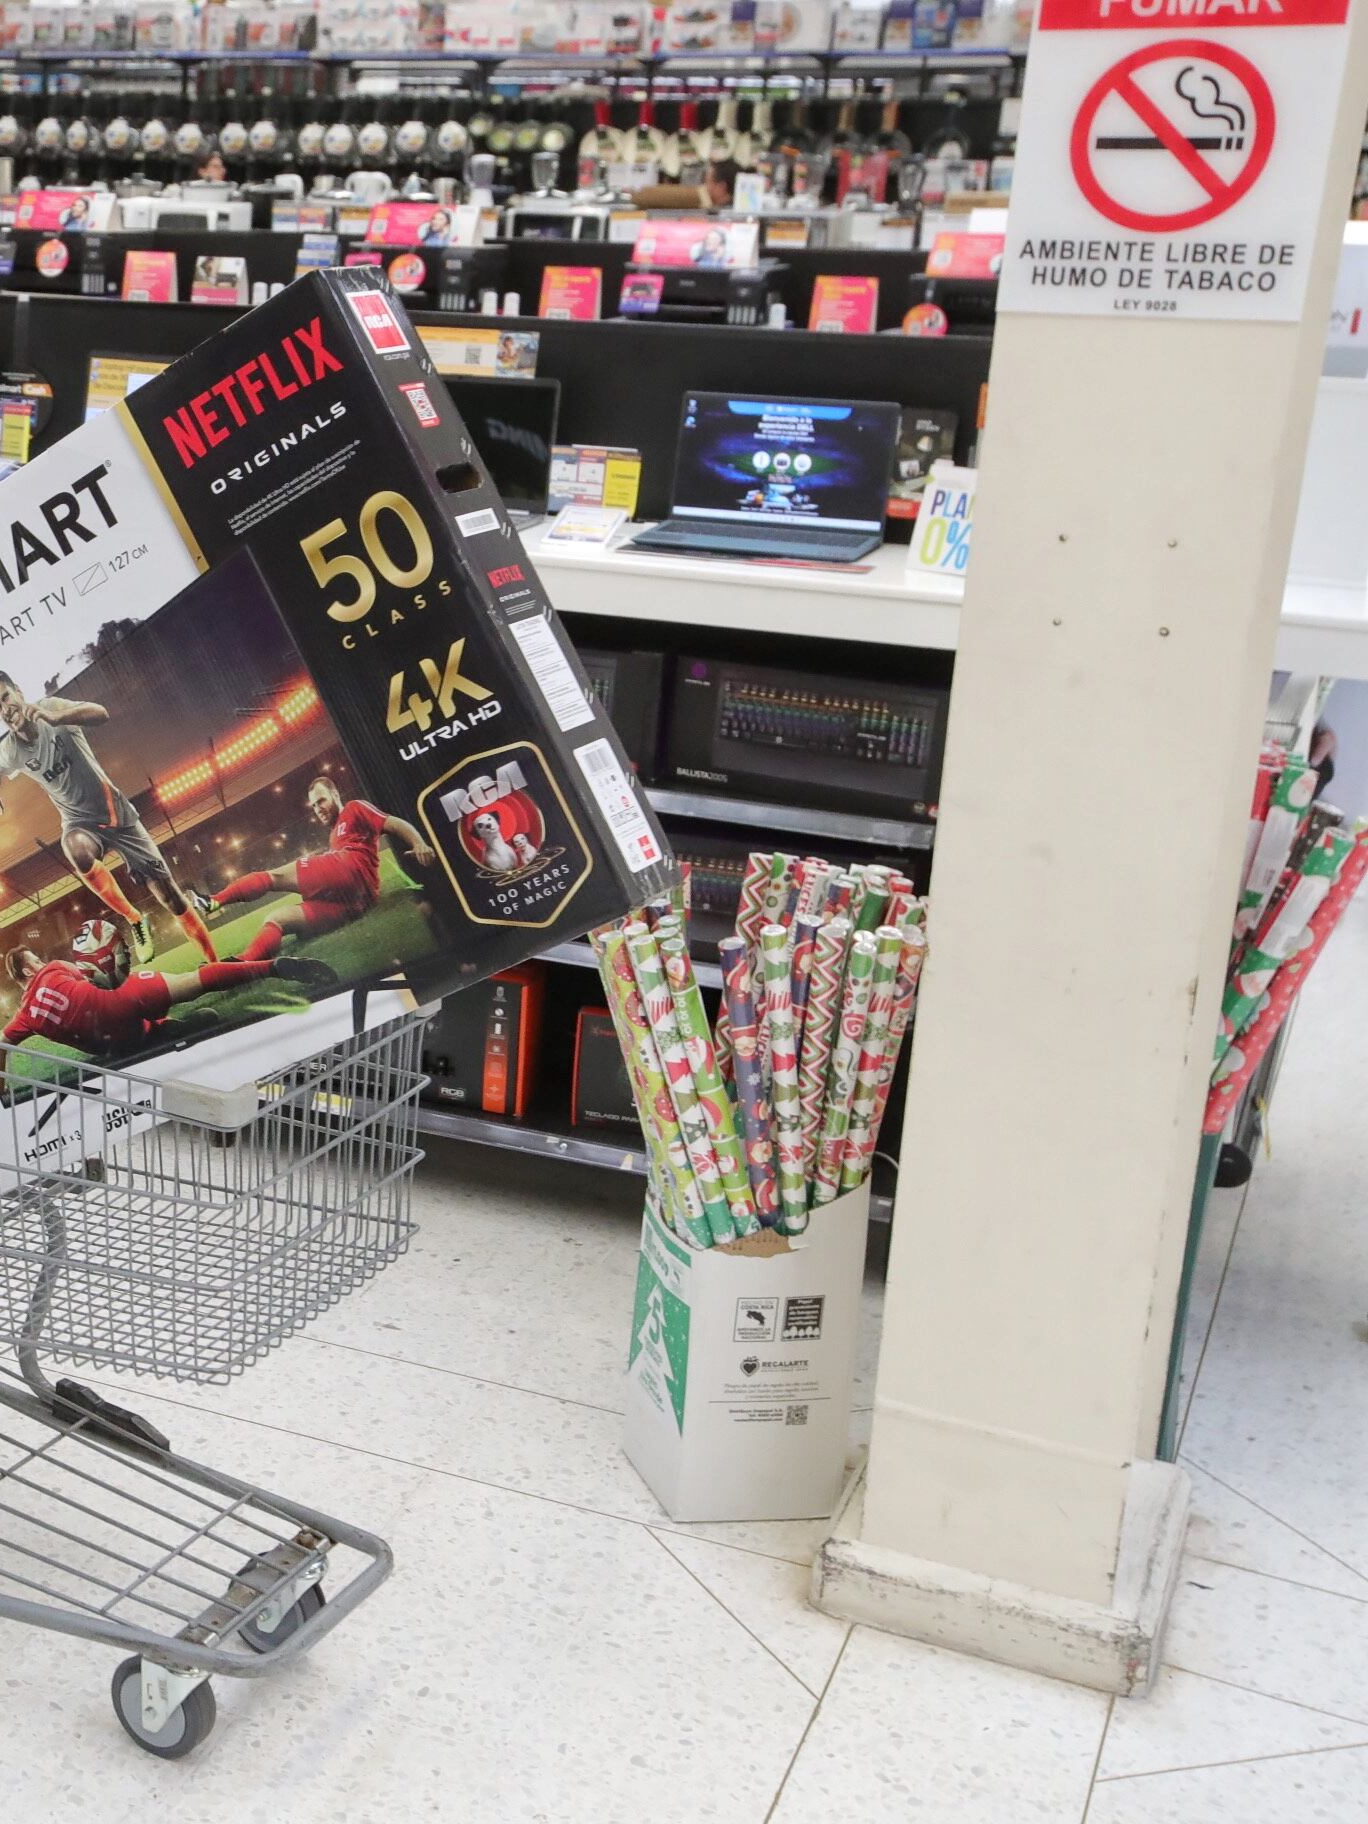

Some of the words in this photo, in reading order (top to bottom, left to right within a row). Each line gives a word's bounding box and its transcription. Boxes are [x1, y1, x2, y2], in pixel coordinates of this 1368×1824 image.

[1019, 239, 1156, 262] AMBIENTE
[1166, 242, 1248, 264] LIBRE
[1258, 244, 1296, 266] DE
[1031, 266, 1108, 288] HUMO
[1118, 268, 1153, 289] DE
[1166, 269, 1277, 292] TABACO
[363, 314, 392, 328] RCA
[1113, 299, 1140, 311] LEY
[1144, 300, 1178, 312] 9028
[162, 316, 345, 469] NETFLIX
[210, 400, 347, 495] ORIGINALS
[299, 490, 434, 623] 50
[919, 517, 973, 570] 0%
[487, 564, 525, 589] NETFLIX
[40, 586, 69, 618] TV
[341, 579, 453, 651] CLASS
[384, 637, 495, 734] 4K
[399, 719, 469, 762] ULTRA
[470, 700, 503, 731] HD
[439, 760, 528, 823] RCA
[487, 887, 520, 909] 100
[522, 863, 571, 891] YEARS
[502, 903, 520, 917] OF
[524, 881, 568, 907] MAGIC
[29, 986, 70, 1026] 10
[440, 1086, 465, 1099] RGB
